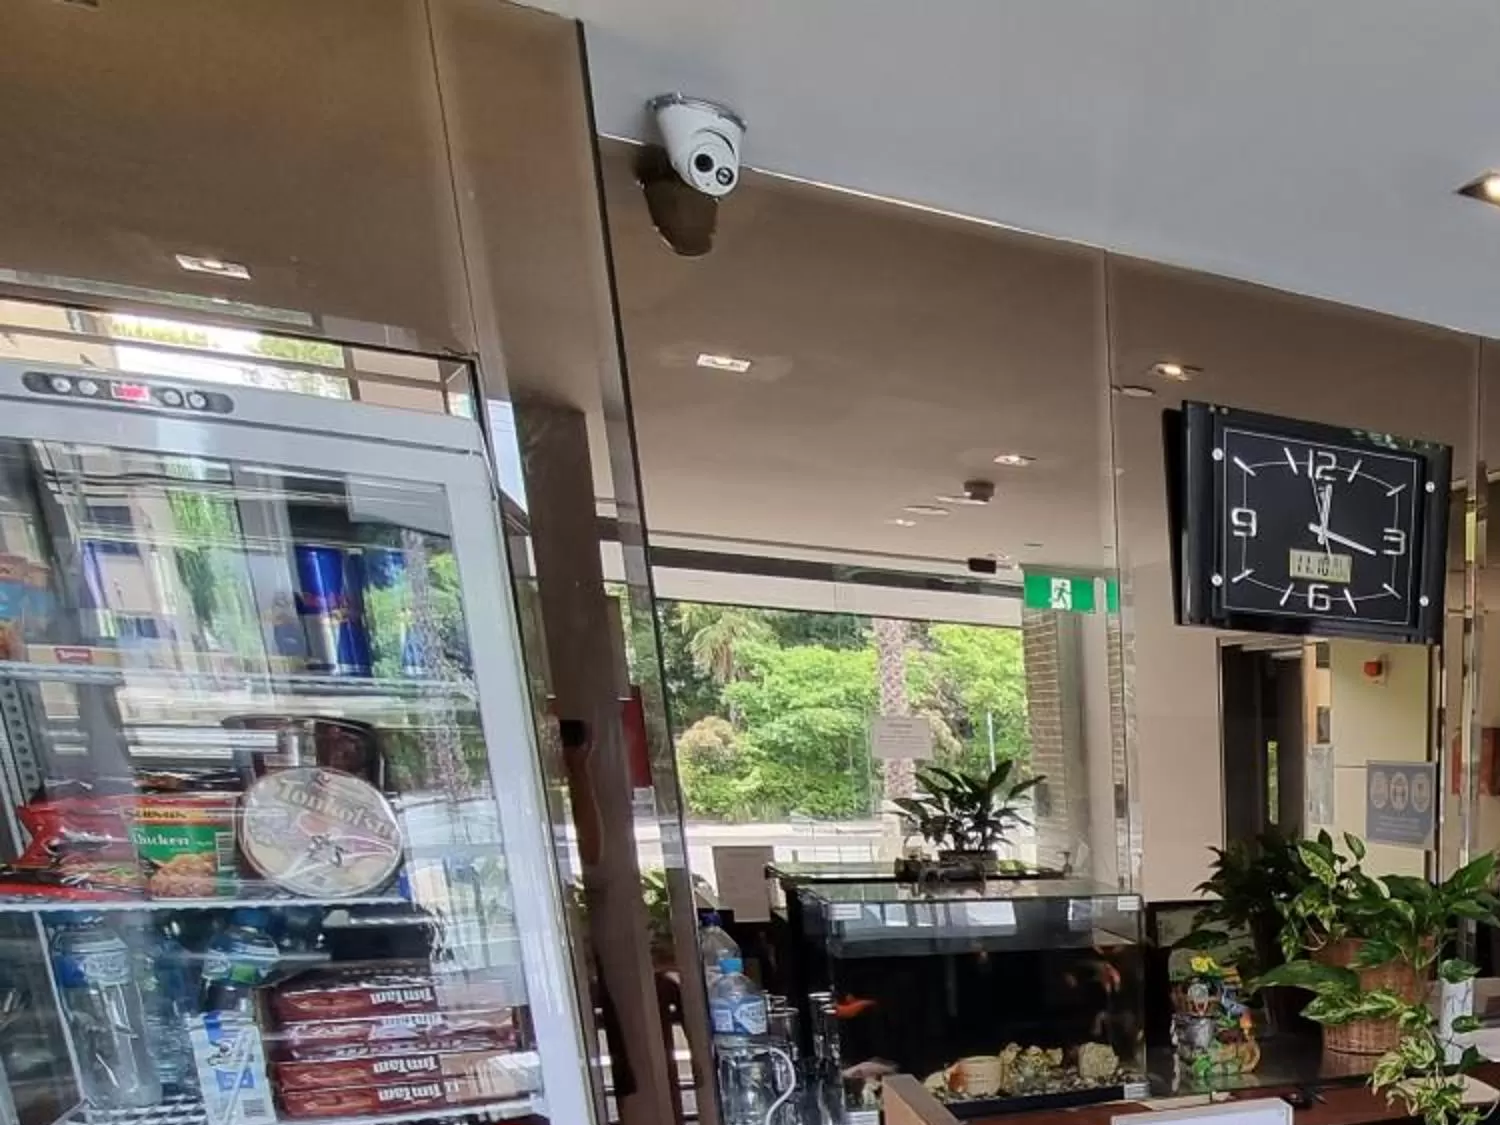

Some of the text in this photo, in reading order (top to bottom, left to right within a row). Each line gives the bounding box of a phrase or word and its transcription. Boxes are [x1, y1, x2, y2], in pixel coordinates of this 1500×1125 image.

[1306, 449, 1337, 481] 12
[1231, 508, 1257, 537] 9
[1383, 528, 1406, 556] 3
[1307, 584, 1331, 611] 6
